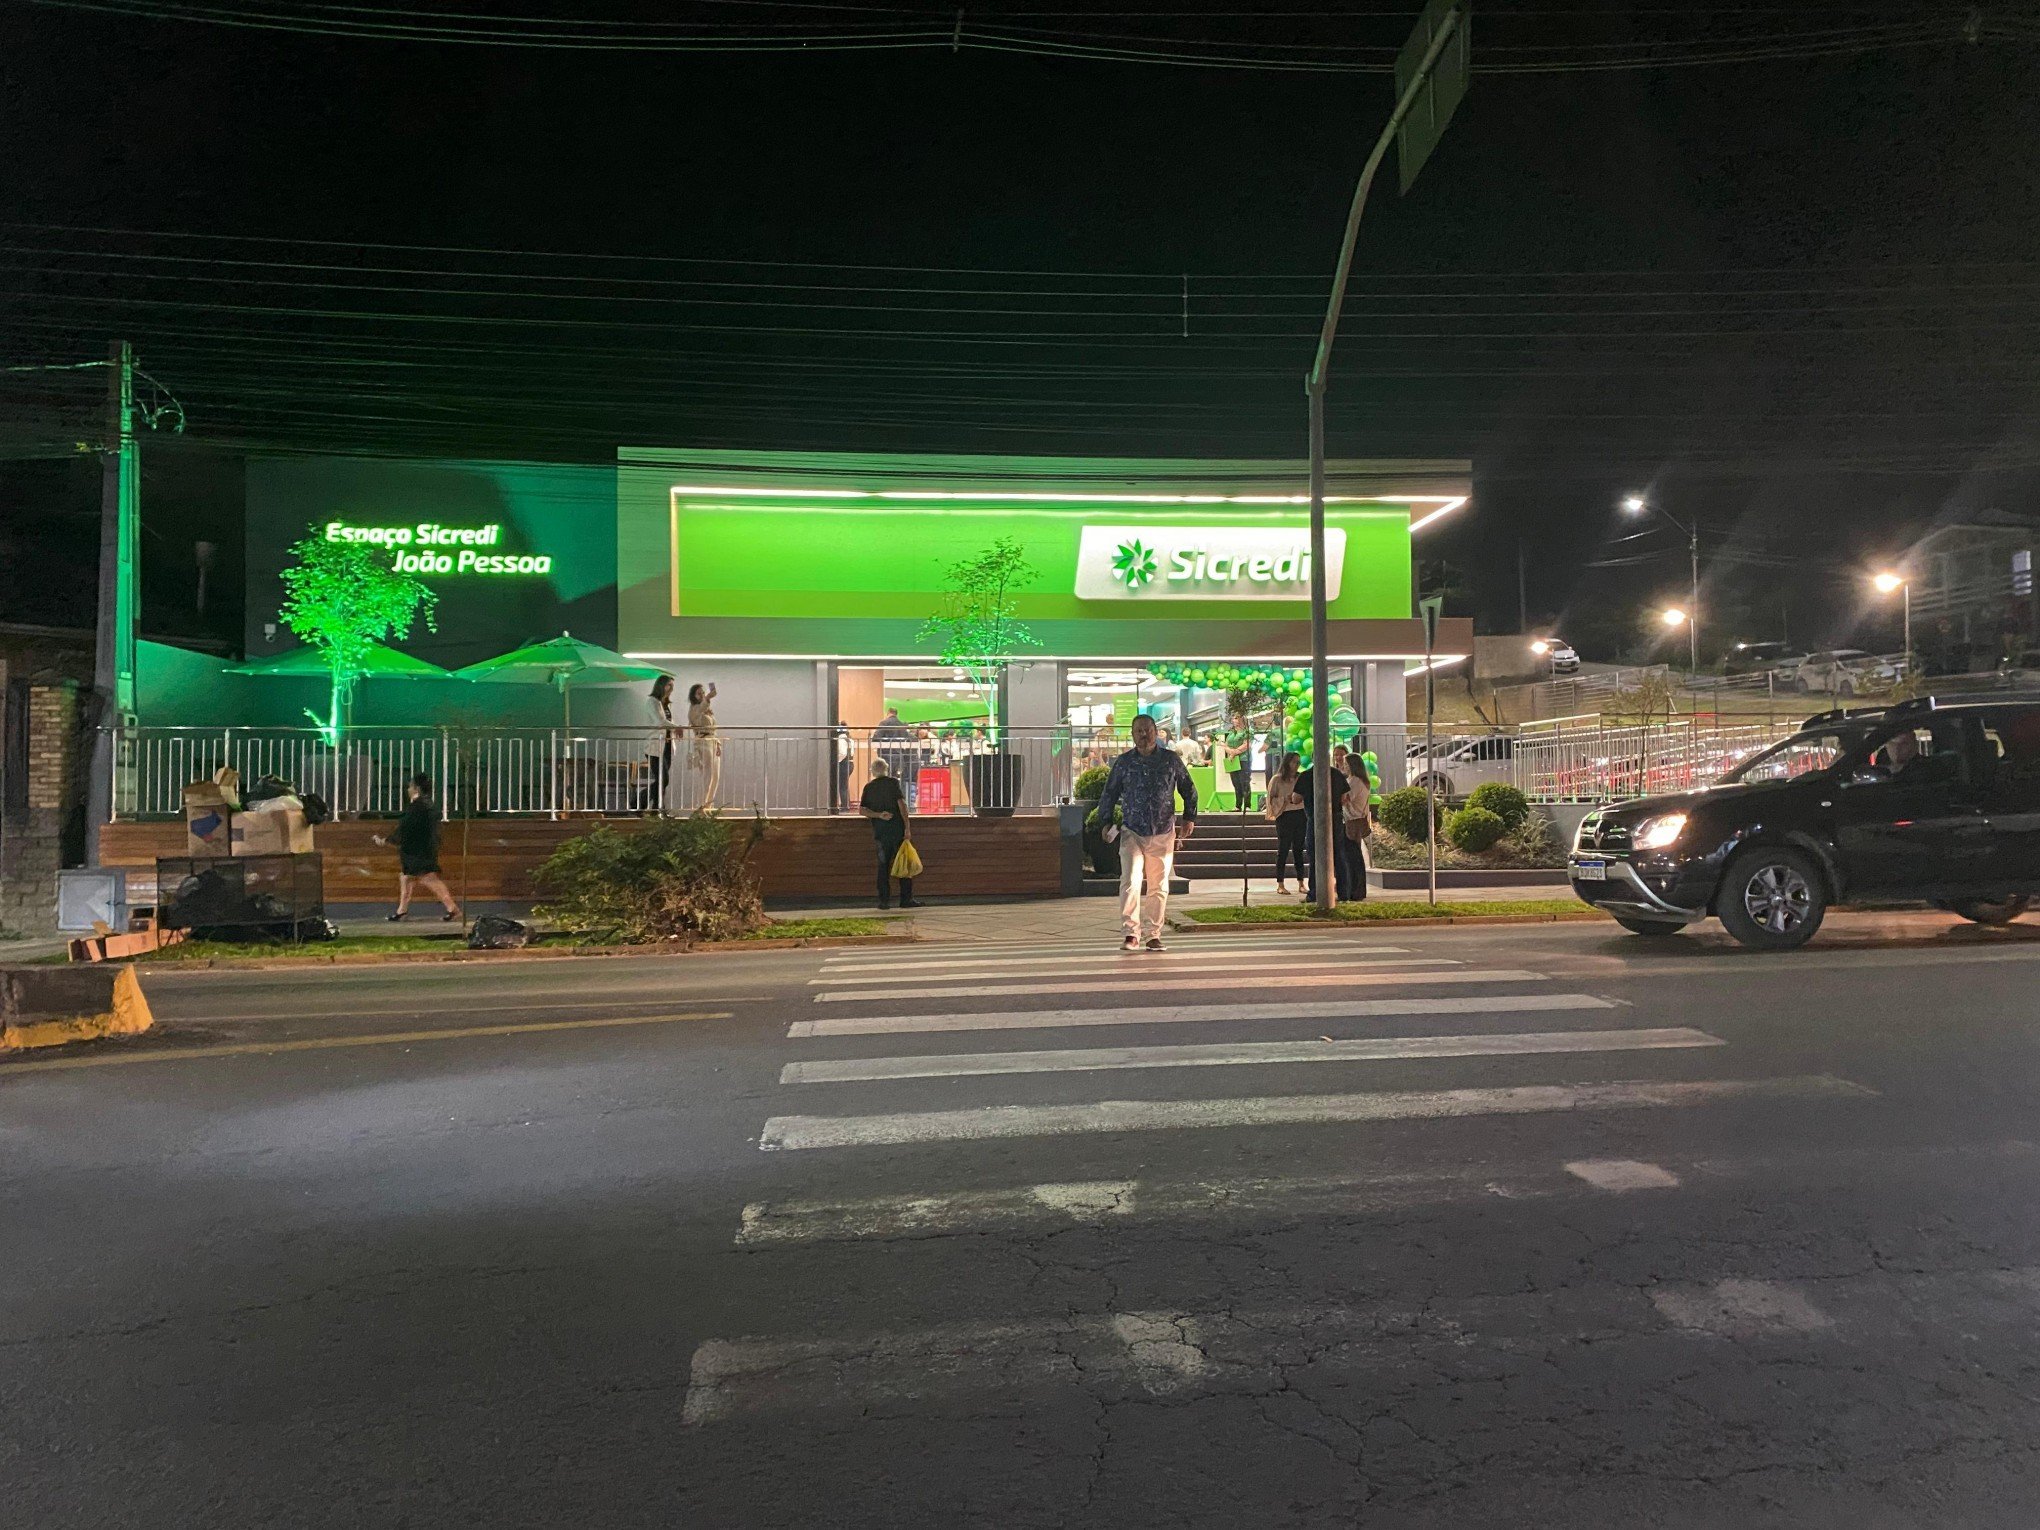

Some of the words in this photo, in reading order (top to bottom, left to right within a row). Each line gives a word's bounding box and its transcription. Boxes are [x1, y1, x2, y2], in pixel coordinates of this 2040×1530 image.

[416, 523, 499, 545] Sicredi
[392, 549, 452, 573] João
[458, 550, 552, 574] Pessoa
[1167, 545, 1312, 582] Sicredi
